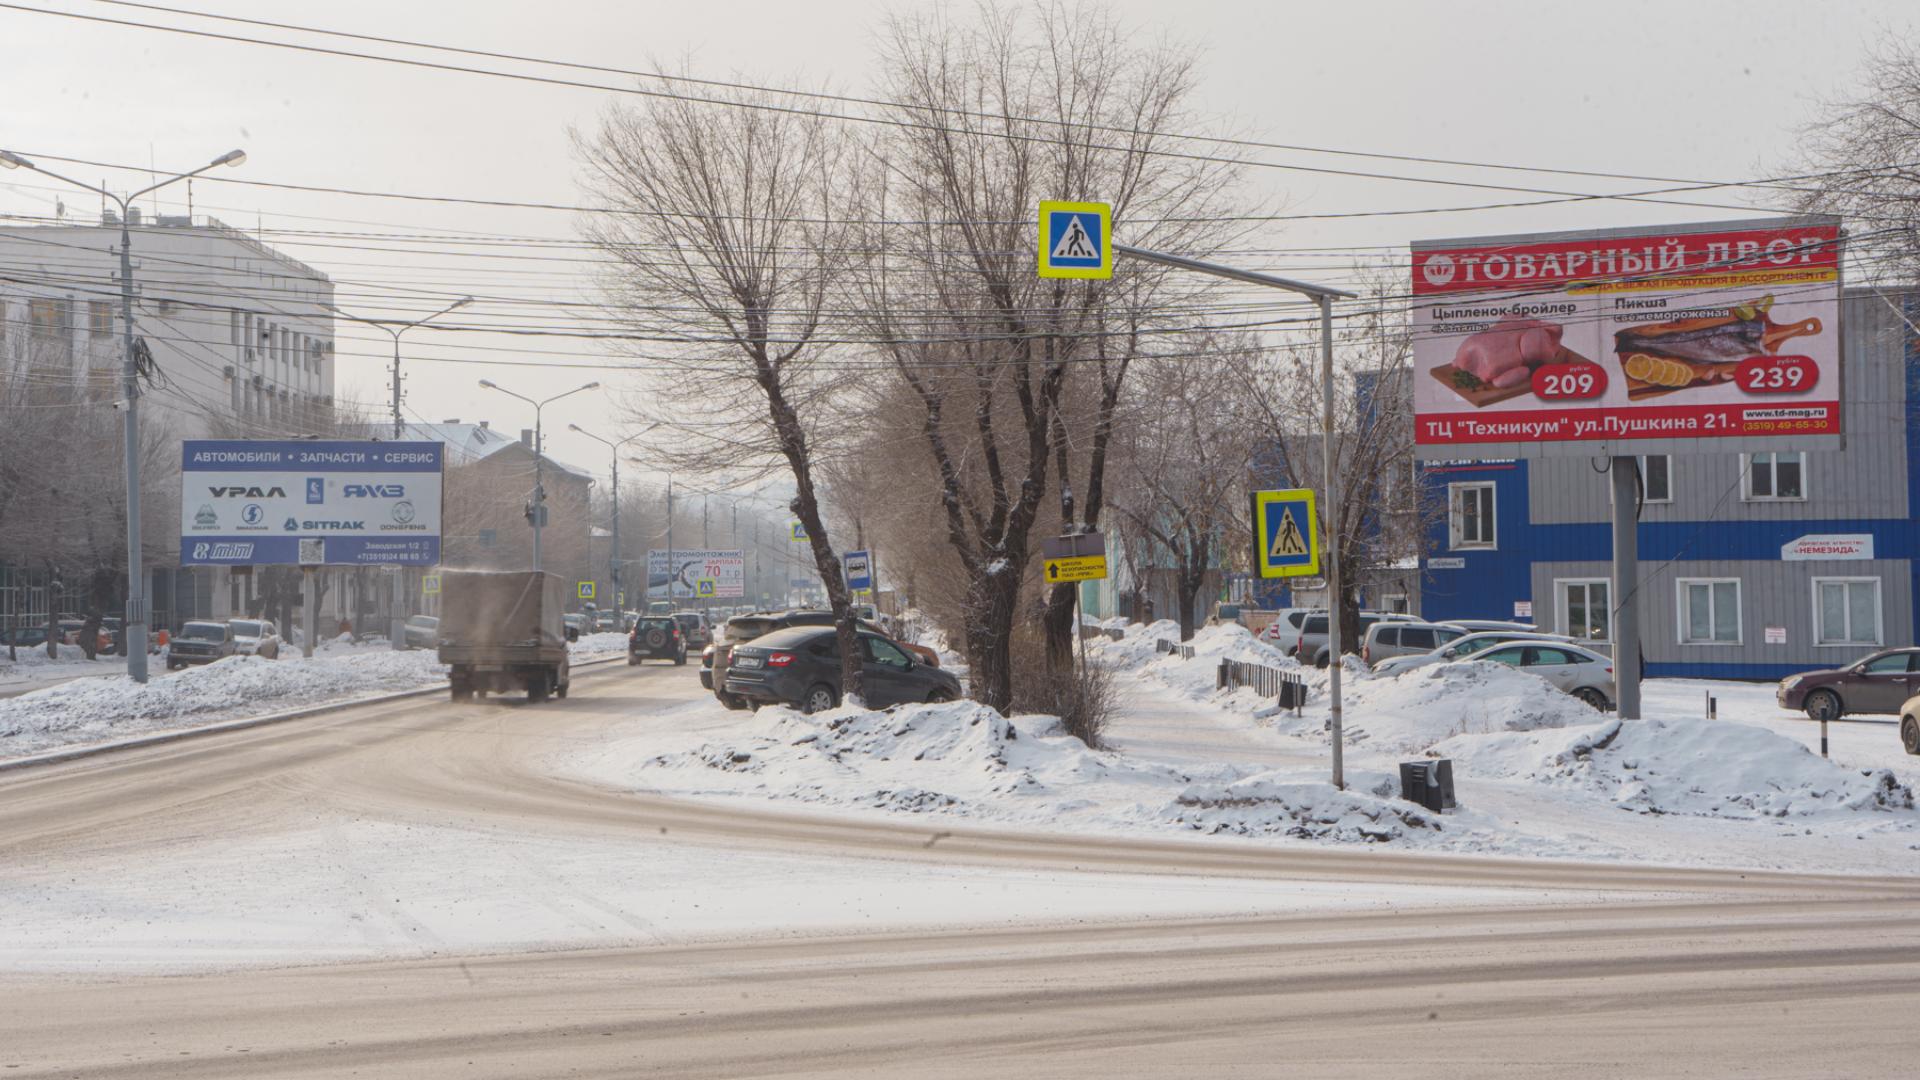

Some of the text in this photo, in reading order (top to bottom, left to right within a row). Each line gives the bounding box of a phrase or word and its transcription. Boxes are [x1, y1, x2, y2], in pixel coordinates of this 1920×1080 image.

[1460, 237, 1824, 281] ТОВАРНЫЙ ДВОР
[1662, 276, 1728, 288] ПРОДУКЦИЯ
[1730, 275, 1737, 283] В
[1739, 271, 1828, 284] АССОРТИМЕНТЕ
[1615, 297, 1667, 309] Пикша
[1432, 302, 1577, 320] Цыпленок-бройлер
[1614, 308, 1729, 324] свежемороженая
[1749, 366, 1803, 388] 239
[1544, 374, 1594, 395] 209
[1745, 408, 1824, 418] www.td-mag.ru
[1426, 413, 1736, 438] ТЦ "Техникум" ул.Пушкина 21.
[1743, 420, 1828, 431] (3519) 49-65-30
[194, 452, 434, 463] АВТОМОБИЛИ ЗАПЧАСТИ СЕРВИС
[208, 486, 286, 498] УРАЛ
[302, 520, 365, 530] SITRAK
[704, 566, 720, 577] 70
